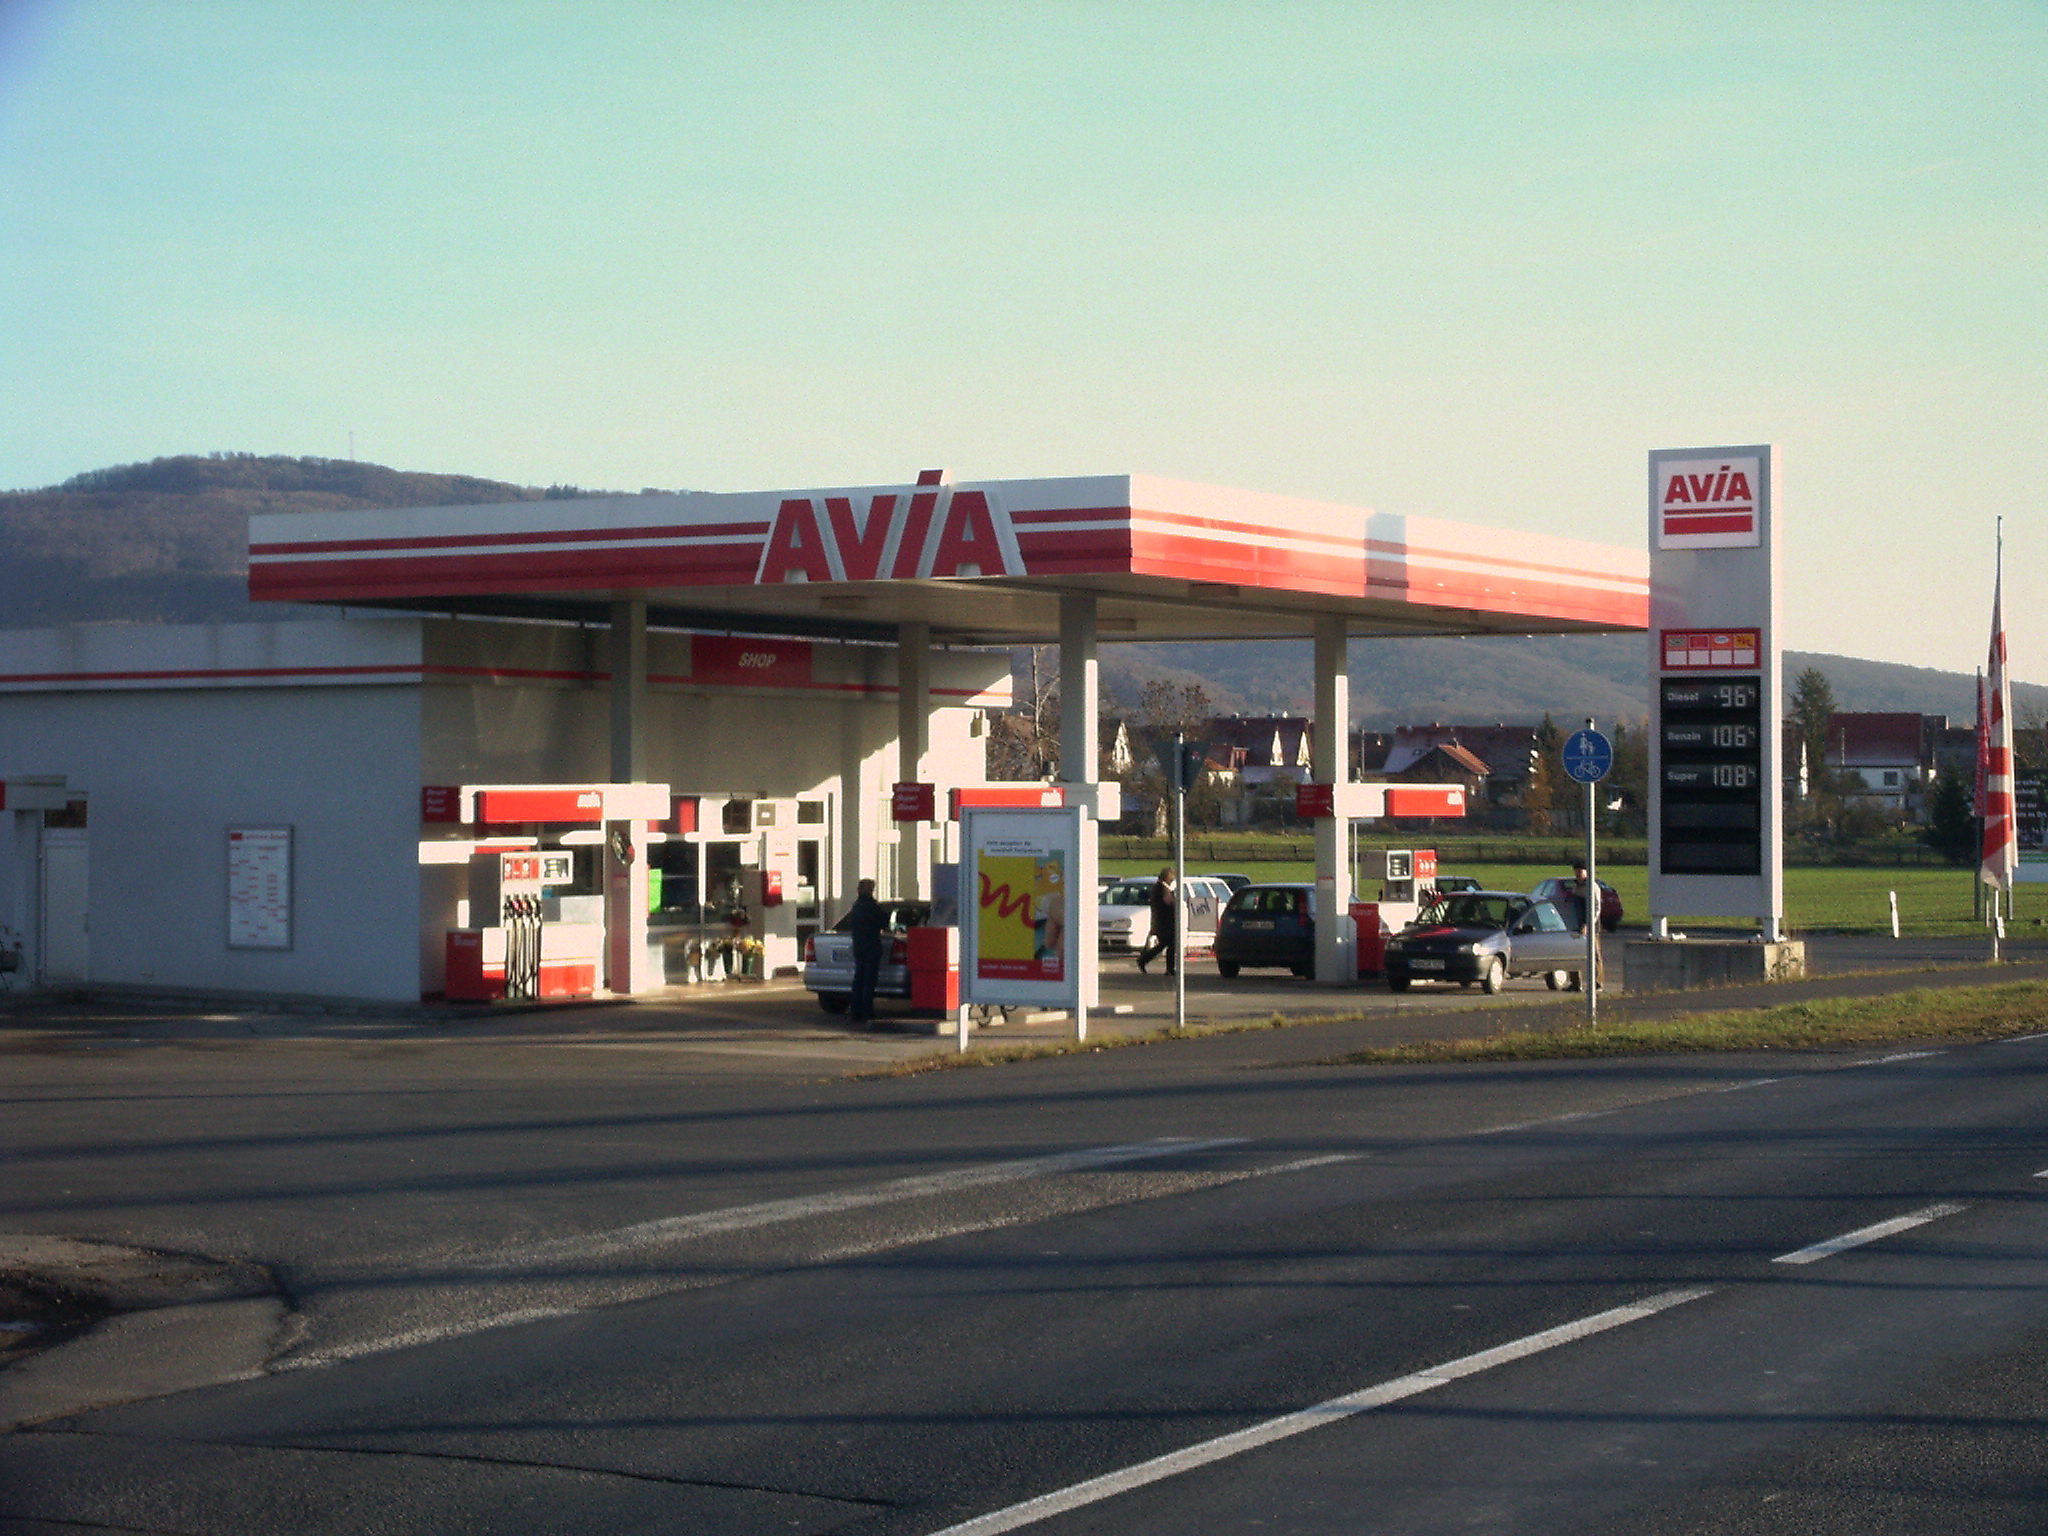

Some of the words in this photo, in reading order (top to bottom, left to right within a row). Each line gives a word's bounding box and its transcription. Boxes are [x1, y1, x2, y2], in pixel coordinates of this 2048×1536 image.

[1663, 465, 1753, 504] AVIA
[758, 469, 1009, 584] AVIA
[737, 652, 777, 668] SHOP
[1666, 691, 1700, 702] Diesel
[1666, 731, 1702, 742] Benzin
[1666, 771, 1699, 783] Super
